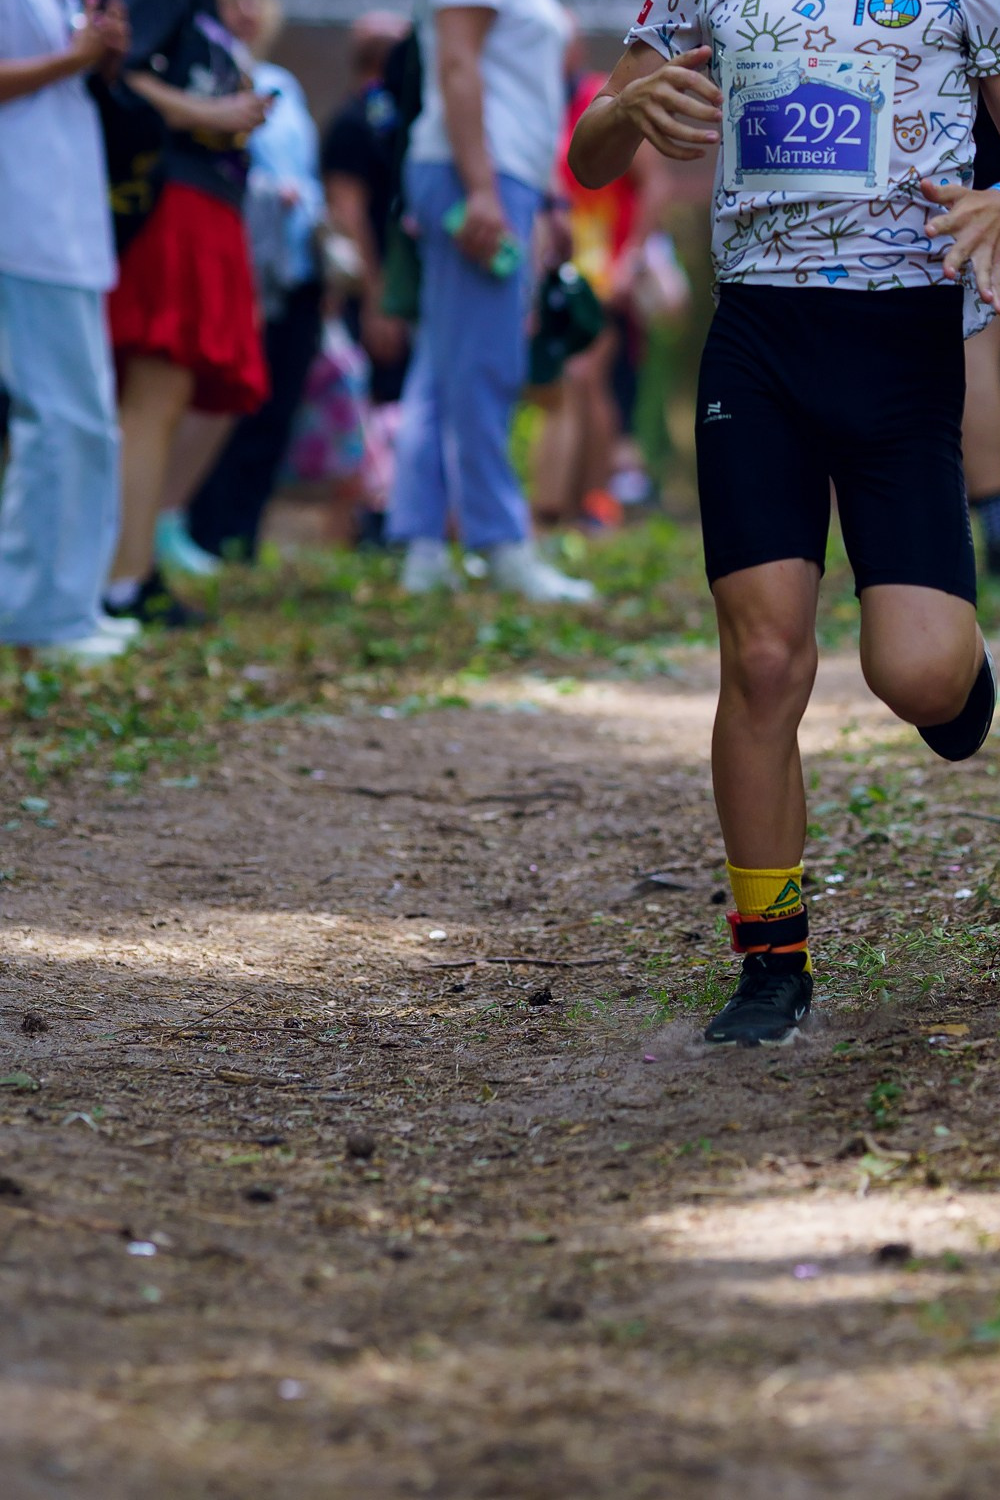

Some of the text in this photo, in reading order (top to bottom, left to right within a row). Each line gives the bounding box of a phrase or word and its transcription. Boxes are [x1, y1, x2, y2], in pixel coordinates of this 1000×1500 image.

[736, 62, 774, 70] СПОРТ 40
[782, 102, 862, 145] 292
[765, 145, 837, 165] Матвей
